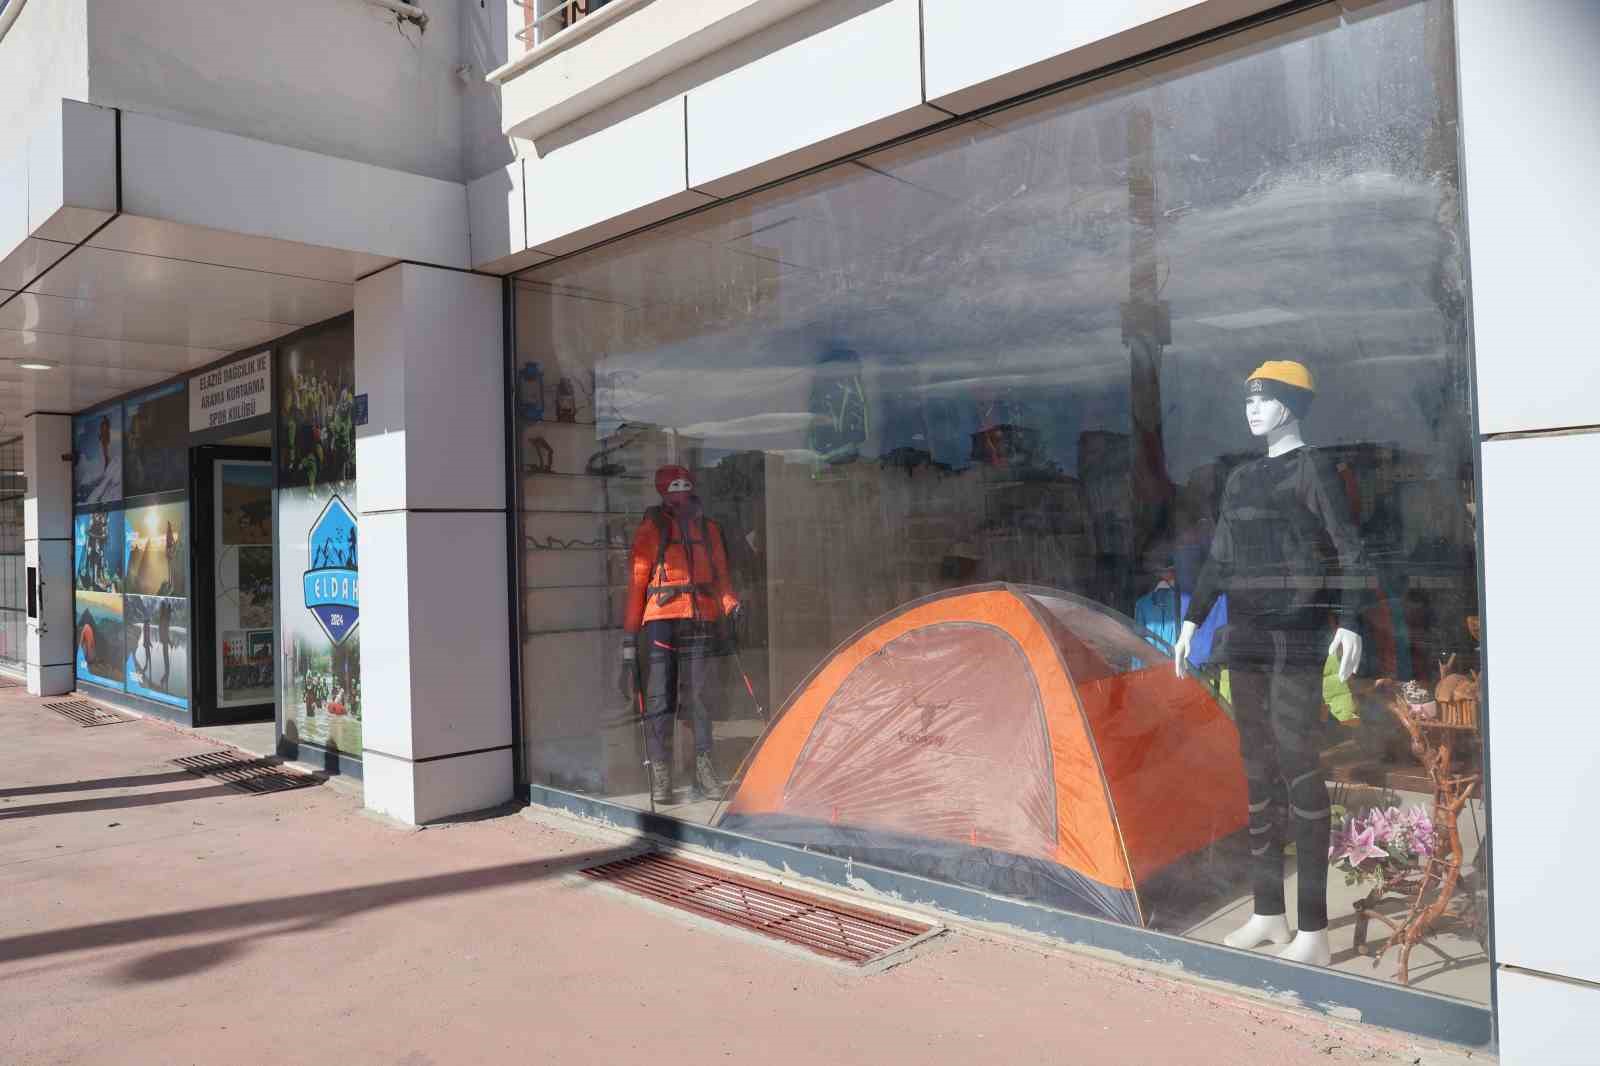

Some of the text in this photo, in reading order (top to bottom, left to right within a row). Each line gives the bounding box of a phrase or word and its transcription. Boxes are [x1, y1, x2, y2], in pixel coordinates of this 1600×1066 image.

[257, 355, 267, 371] VE
[201, 377, 265, 409] ARAMA KURTARMA
[209, 408, 226, 426] SPOR
[330, 613, 344, 626] 2024
